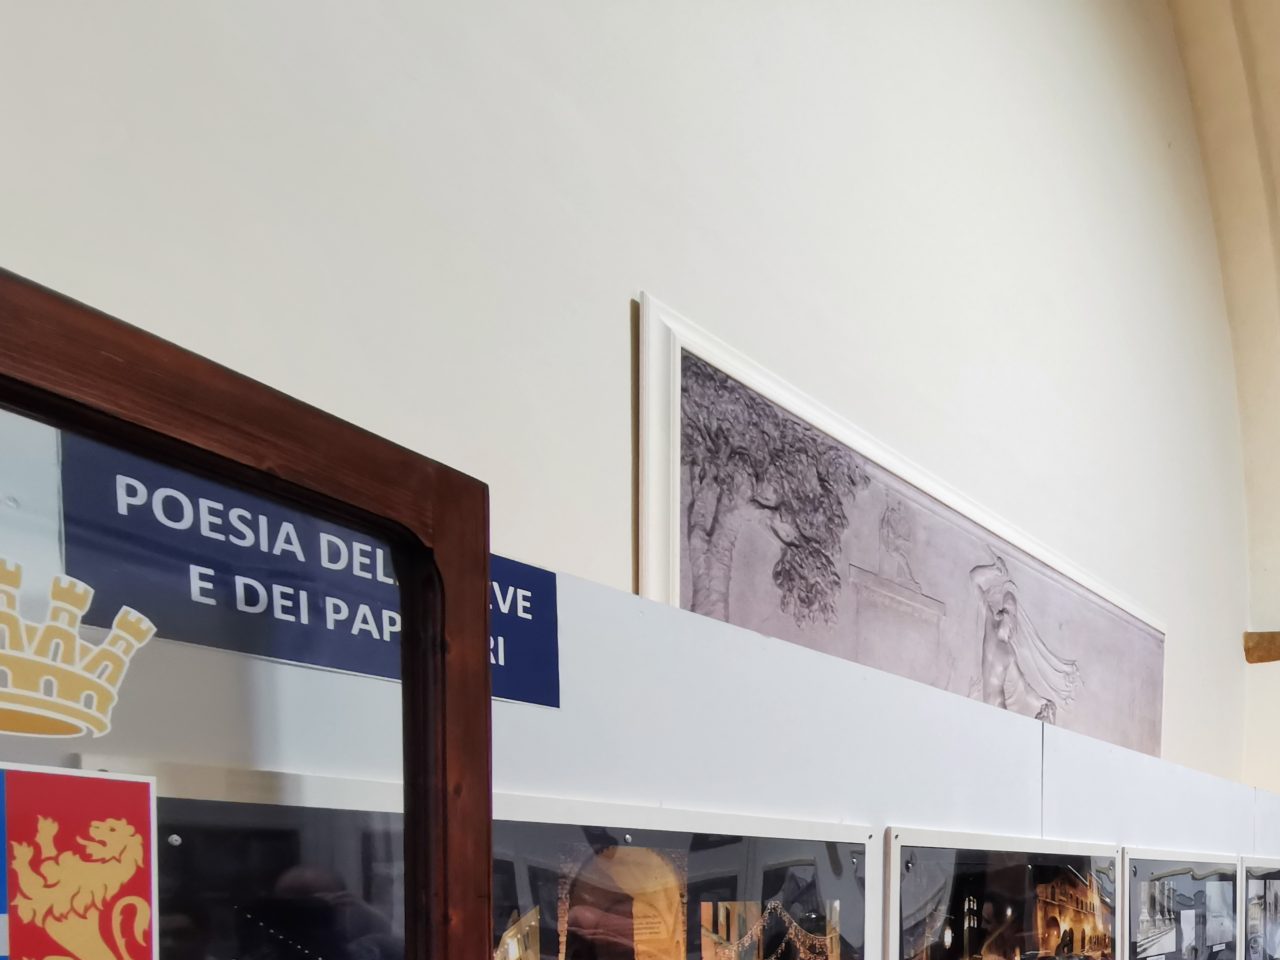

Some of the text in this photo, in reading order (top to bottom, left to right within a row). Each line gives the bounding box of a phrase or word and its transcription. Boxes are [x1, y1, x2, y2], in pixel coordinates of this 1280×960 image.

[115, 474, 533, 620] POESIA DEL VE
[189, 564, 217, 606] E
[235, 575, 309, 625] DEI
